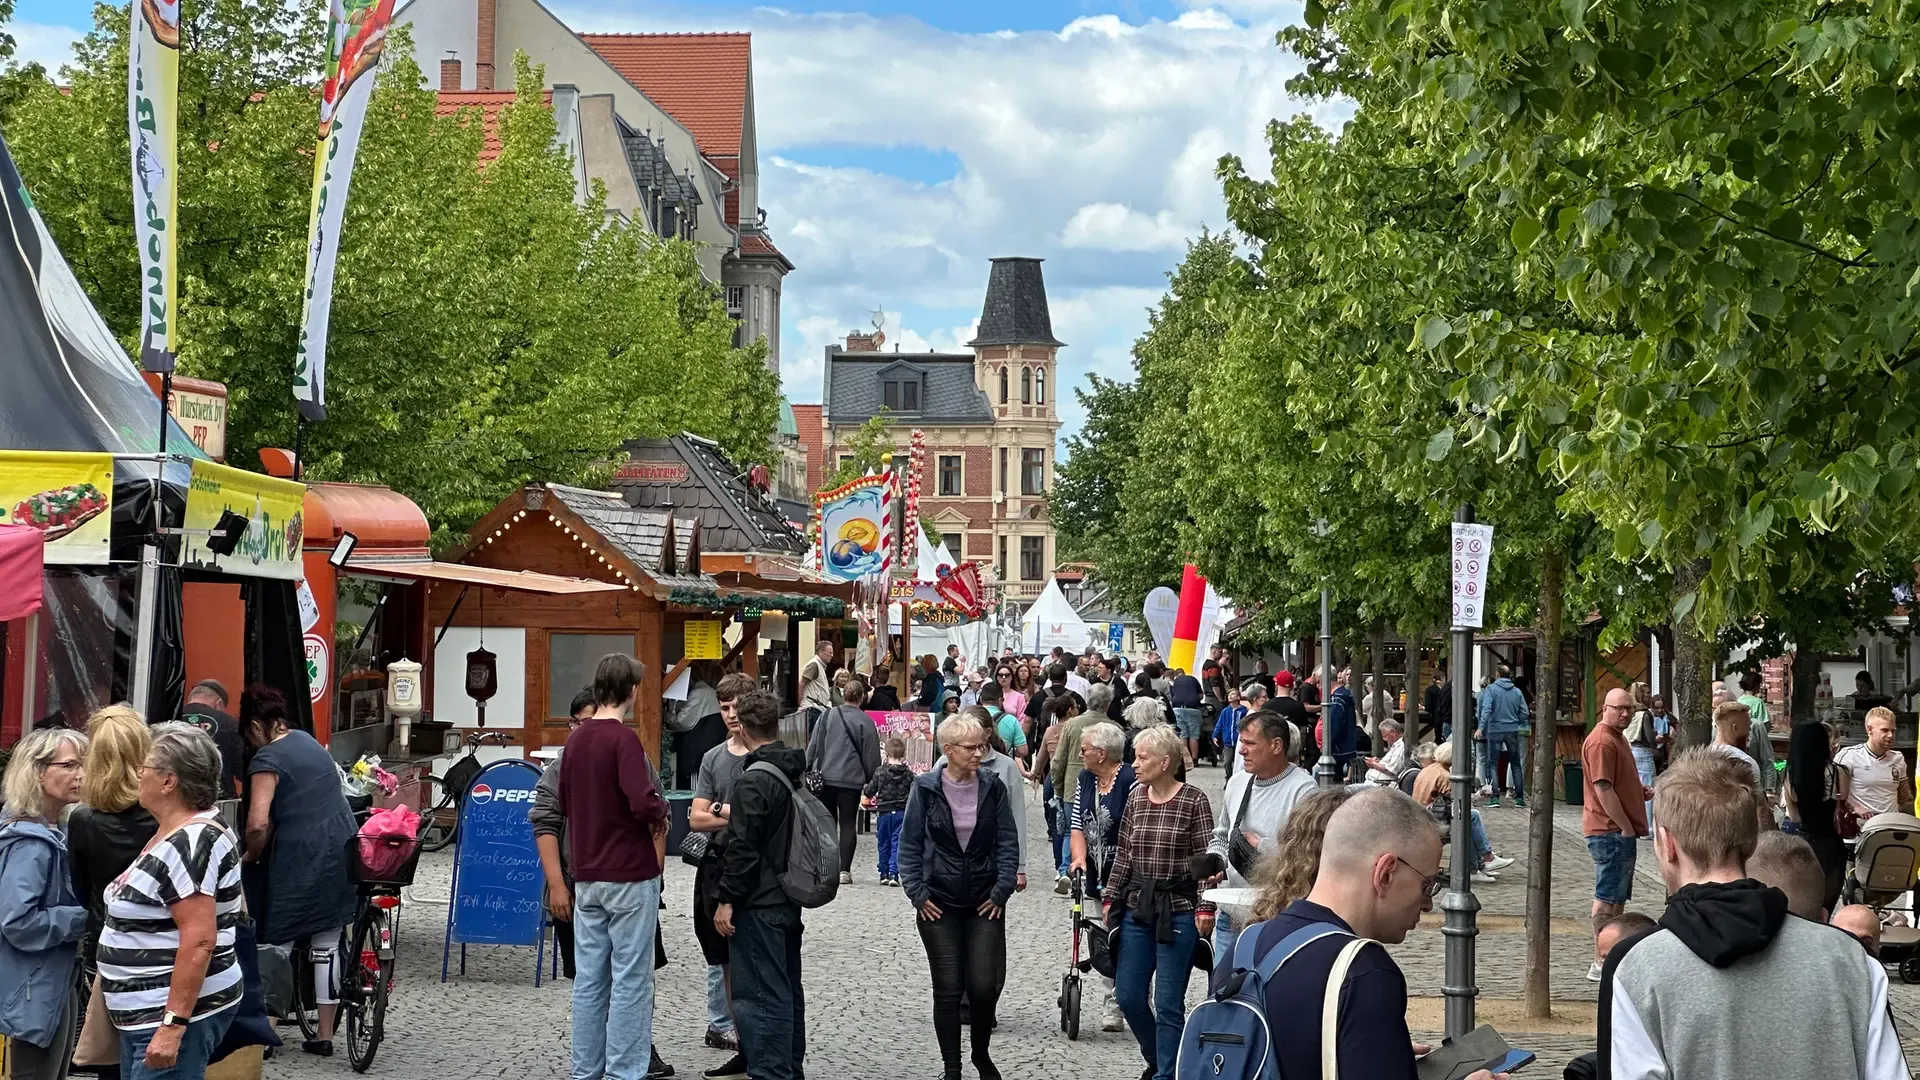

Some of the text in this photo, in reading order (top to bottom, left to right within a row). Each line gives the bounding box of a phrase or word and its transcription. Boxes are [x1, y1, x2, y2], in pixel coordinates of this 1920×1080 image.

[890, 587, 914, 597] EIS
[305, 645, 320, 659] EP
[493, 788, 538, 803] PEPS
